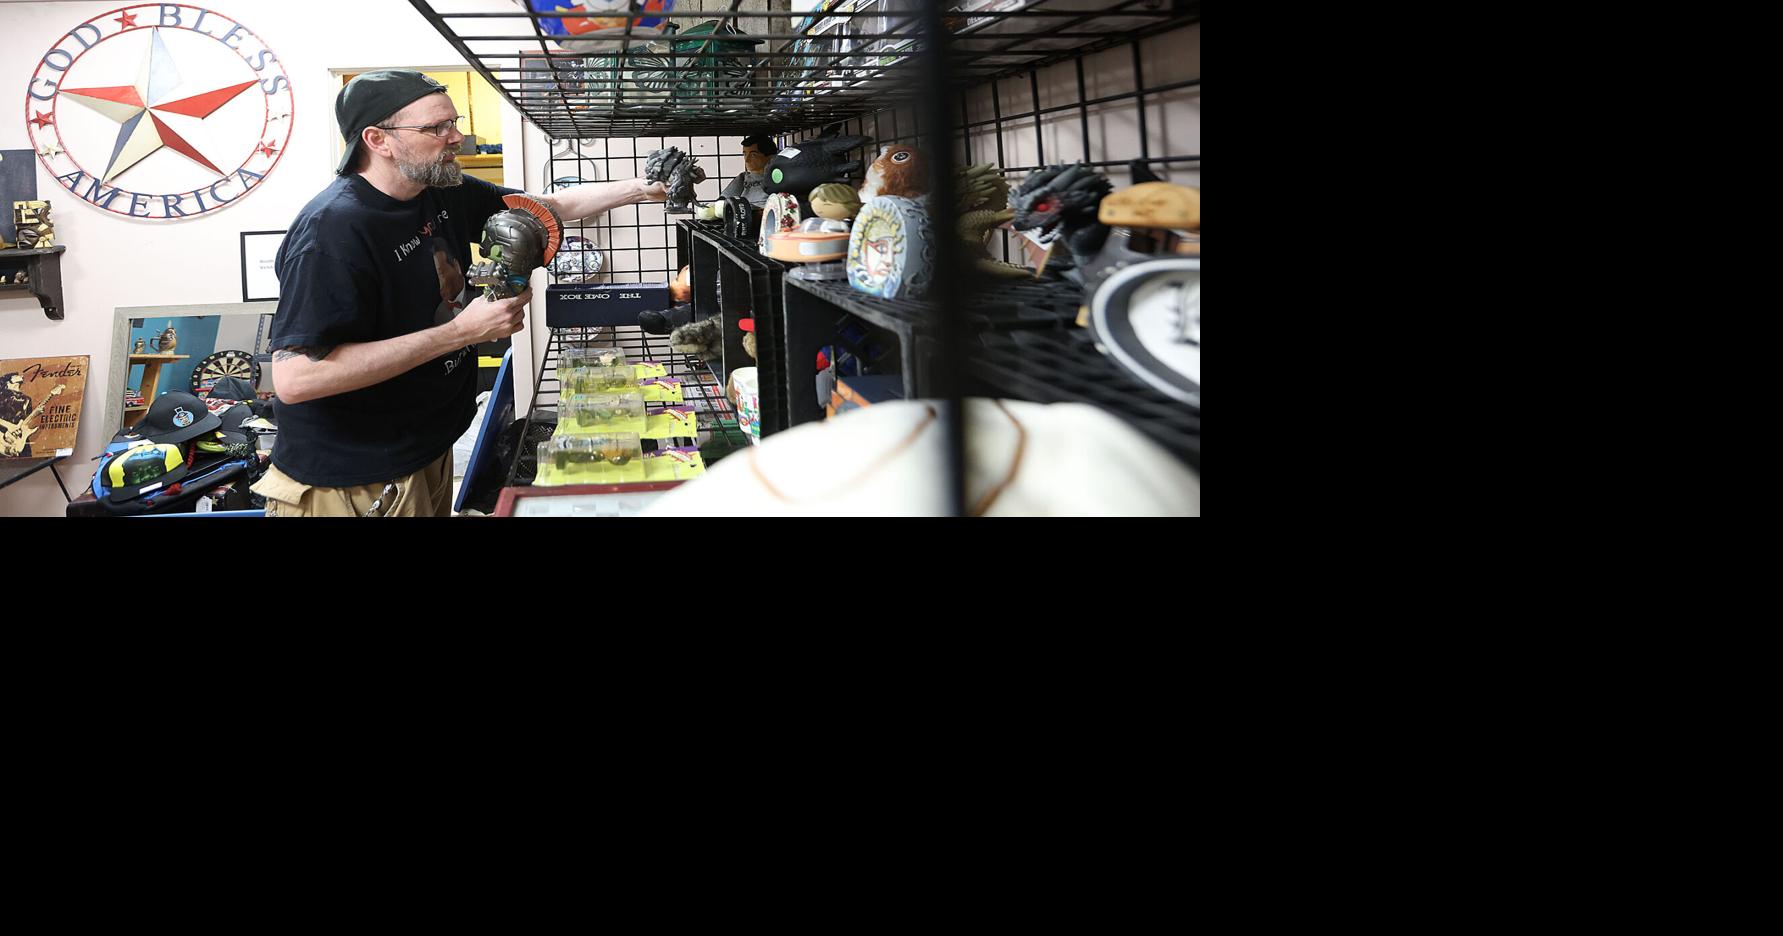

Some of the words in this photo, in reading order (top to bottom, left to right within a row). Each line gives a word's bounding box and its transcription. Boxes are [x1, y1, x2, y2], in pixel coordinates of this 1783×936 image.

[28, 23, 102, 101] GOD
[159, 3, 290, 95] BLESS
[57, 168, 264, 218] AMERICA
[394, 249, 402, 262] I
[399, 236, 421, 257] Know
[23, 362, 82, 382] Fender
[41, 413, 77, 423] ELECTRIC
[50, 405, 71, 413] FINE
